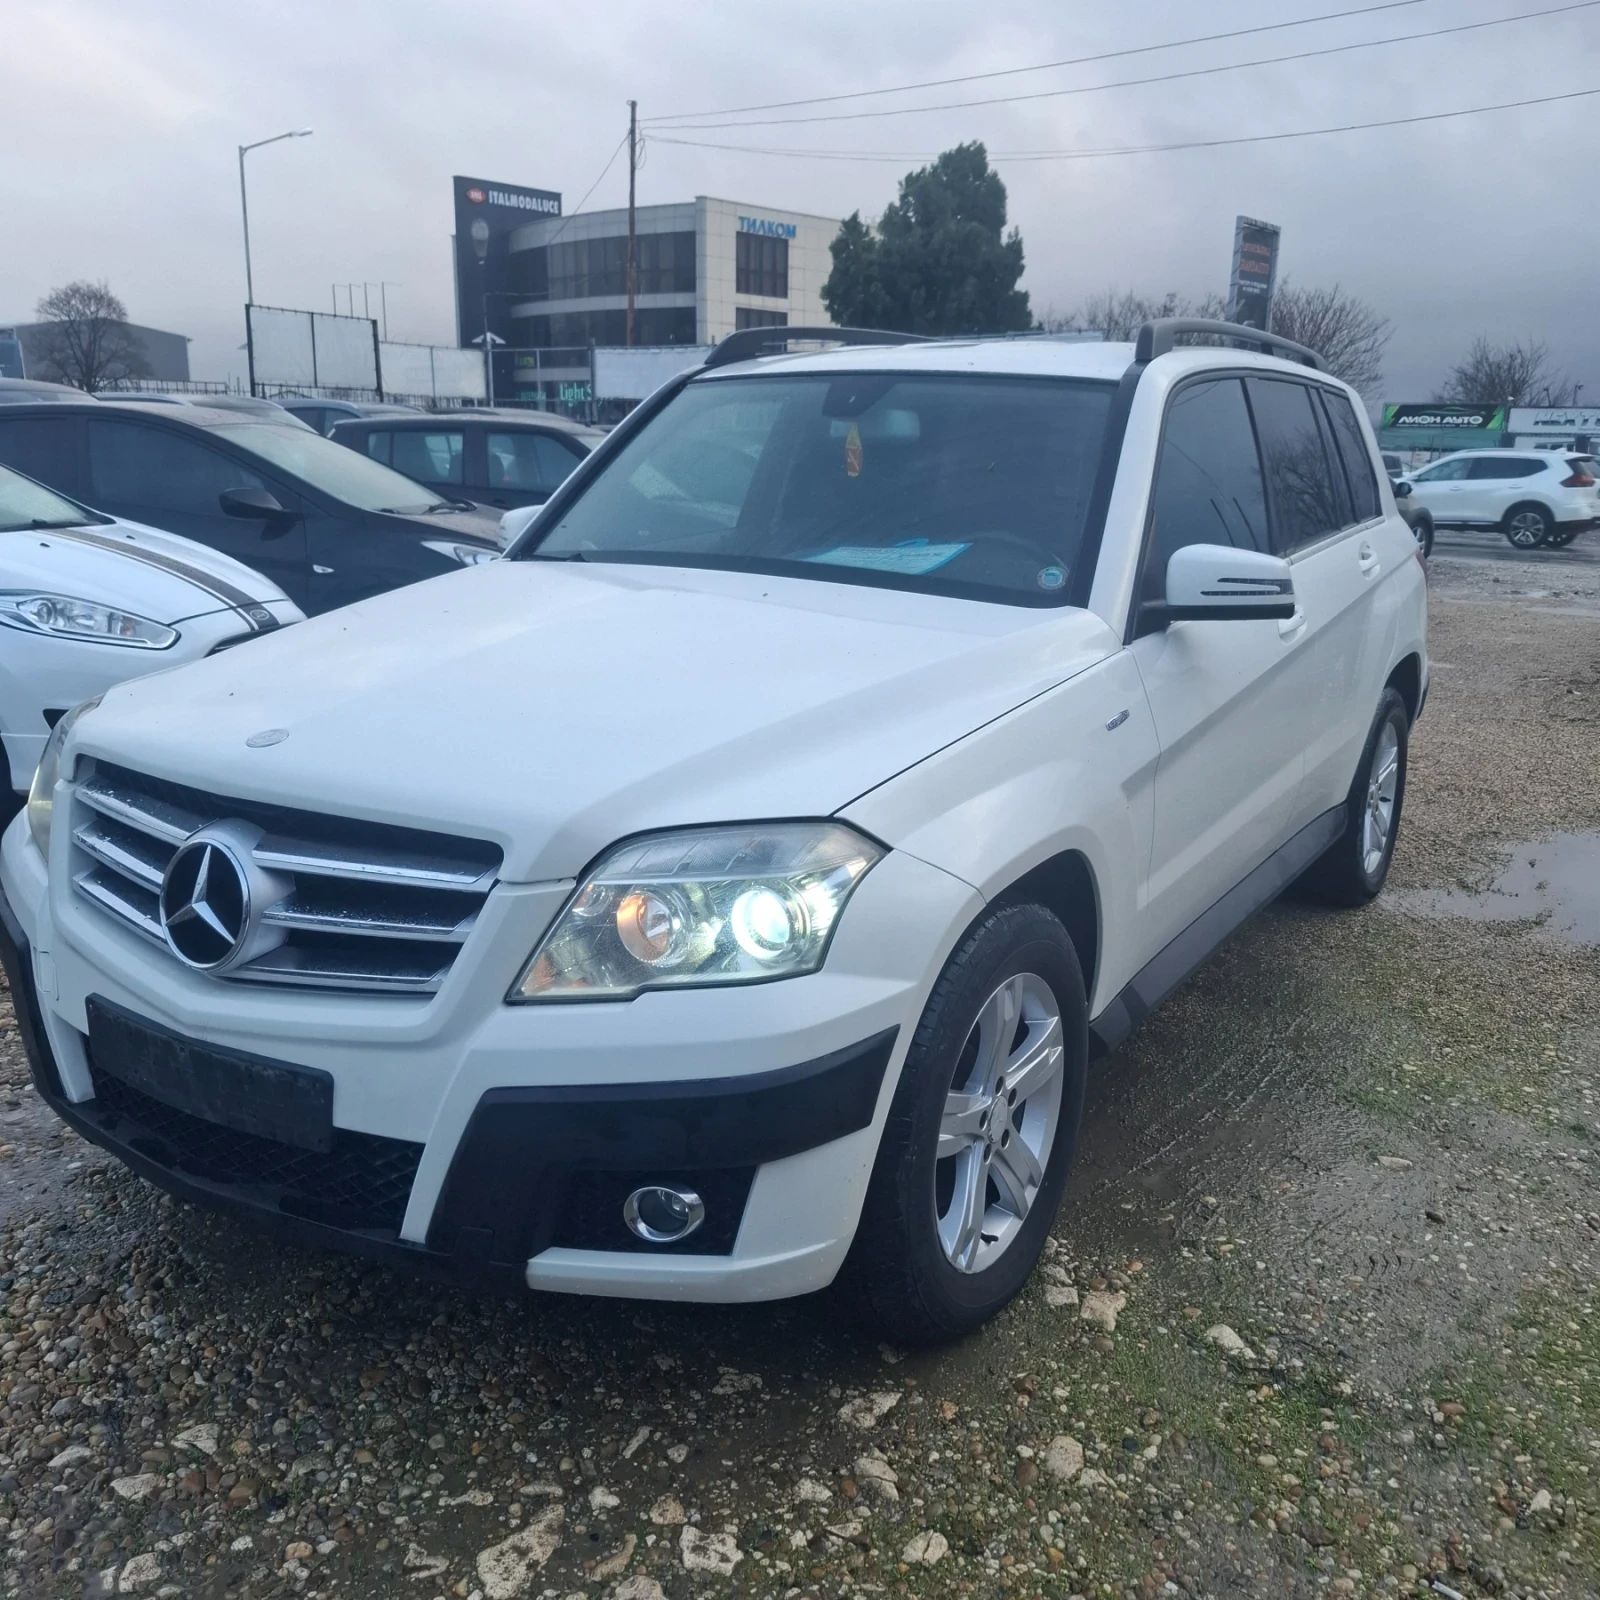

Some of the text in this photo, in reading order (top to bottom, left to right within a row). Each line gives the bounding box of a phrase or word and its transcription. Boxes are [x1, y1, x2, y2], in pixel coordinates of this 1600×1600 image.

[488, 190, 560, 214] ITALMODALUCE
[738, 215, 796, 239] ТИЛКОМ
[560, 381, 584, 407] Light
[1398, 415, 1483, 425] ЛИОН АУТО
